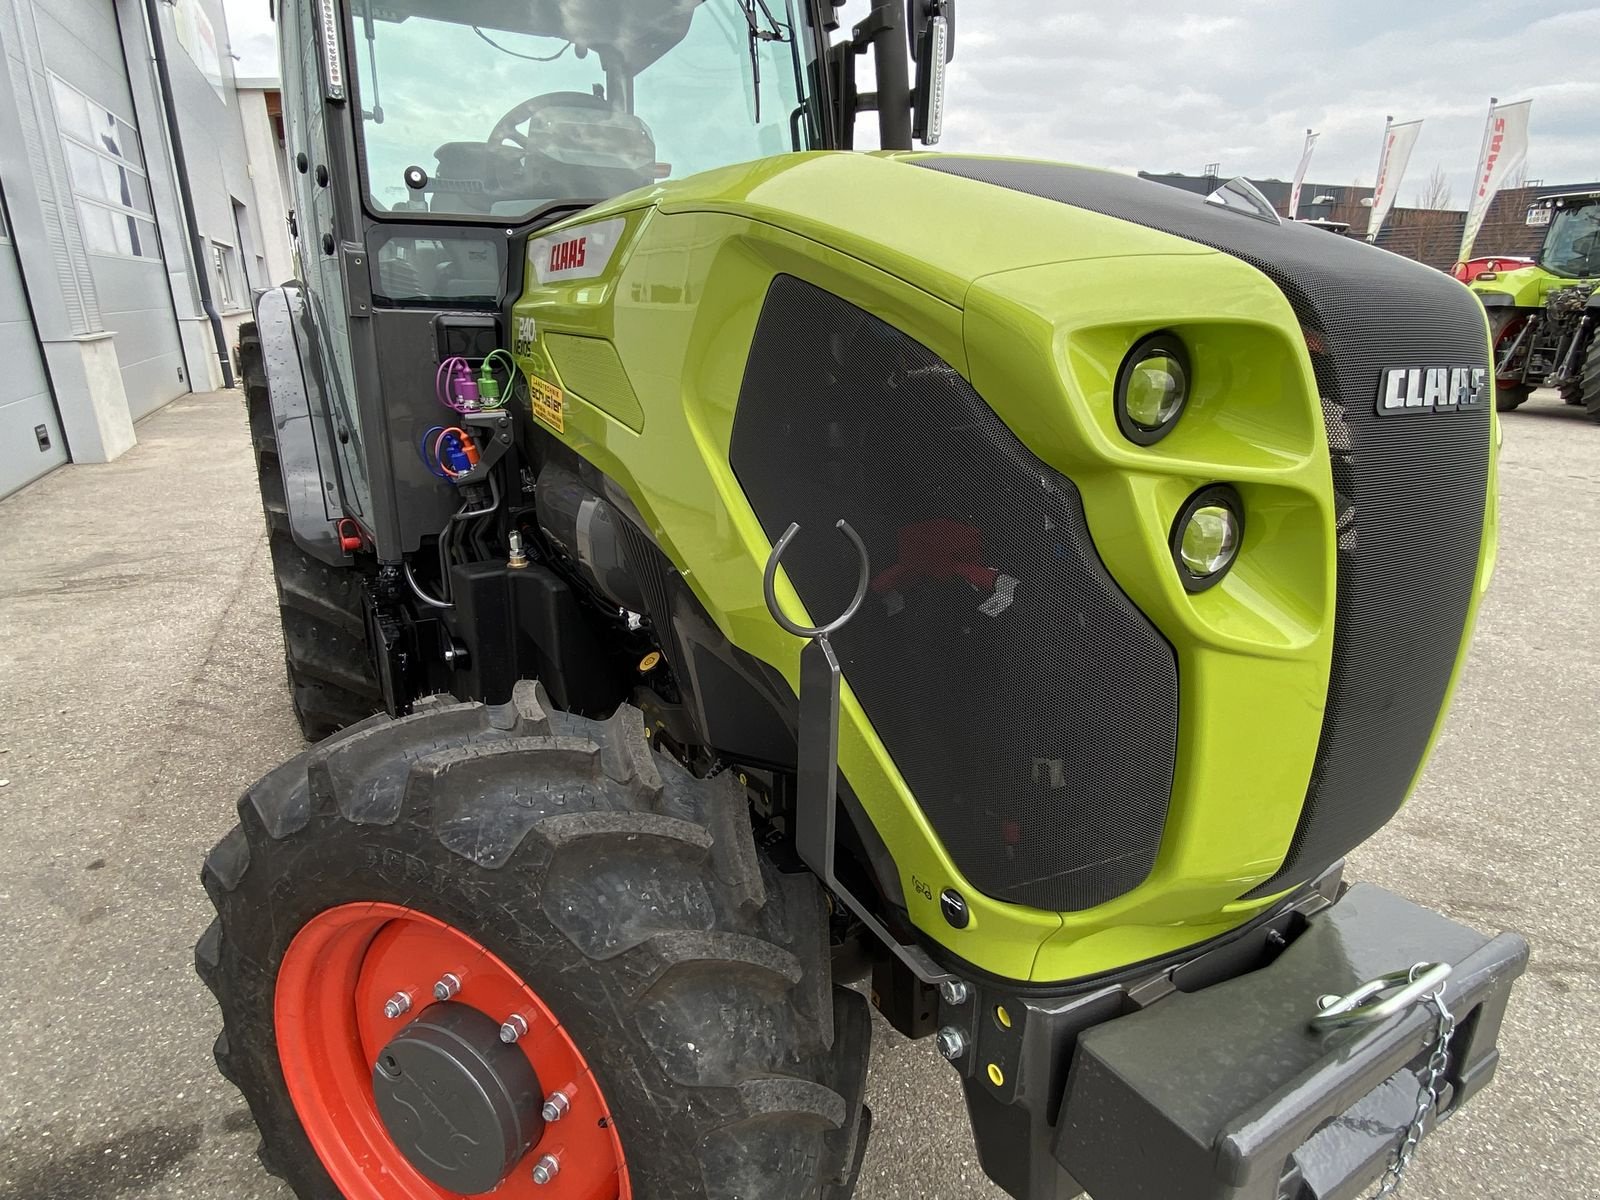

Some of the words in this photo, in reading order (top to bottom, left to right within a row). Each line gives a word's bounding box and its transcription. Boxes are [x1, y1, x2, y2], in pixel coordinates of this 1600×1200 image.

[550, 237, 586, 272] CLAAS
[518, 317, 536, 342] 240
[1384, 368, 1486, 409] CLAAS
